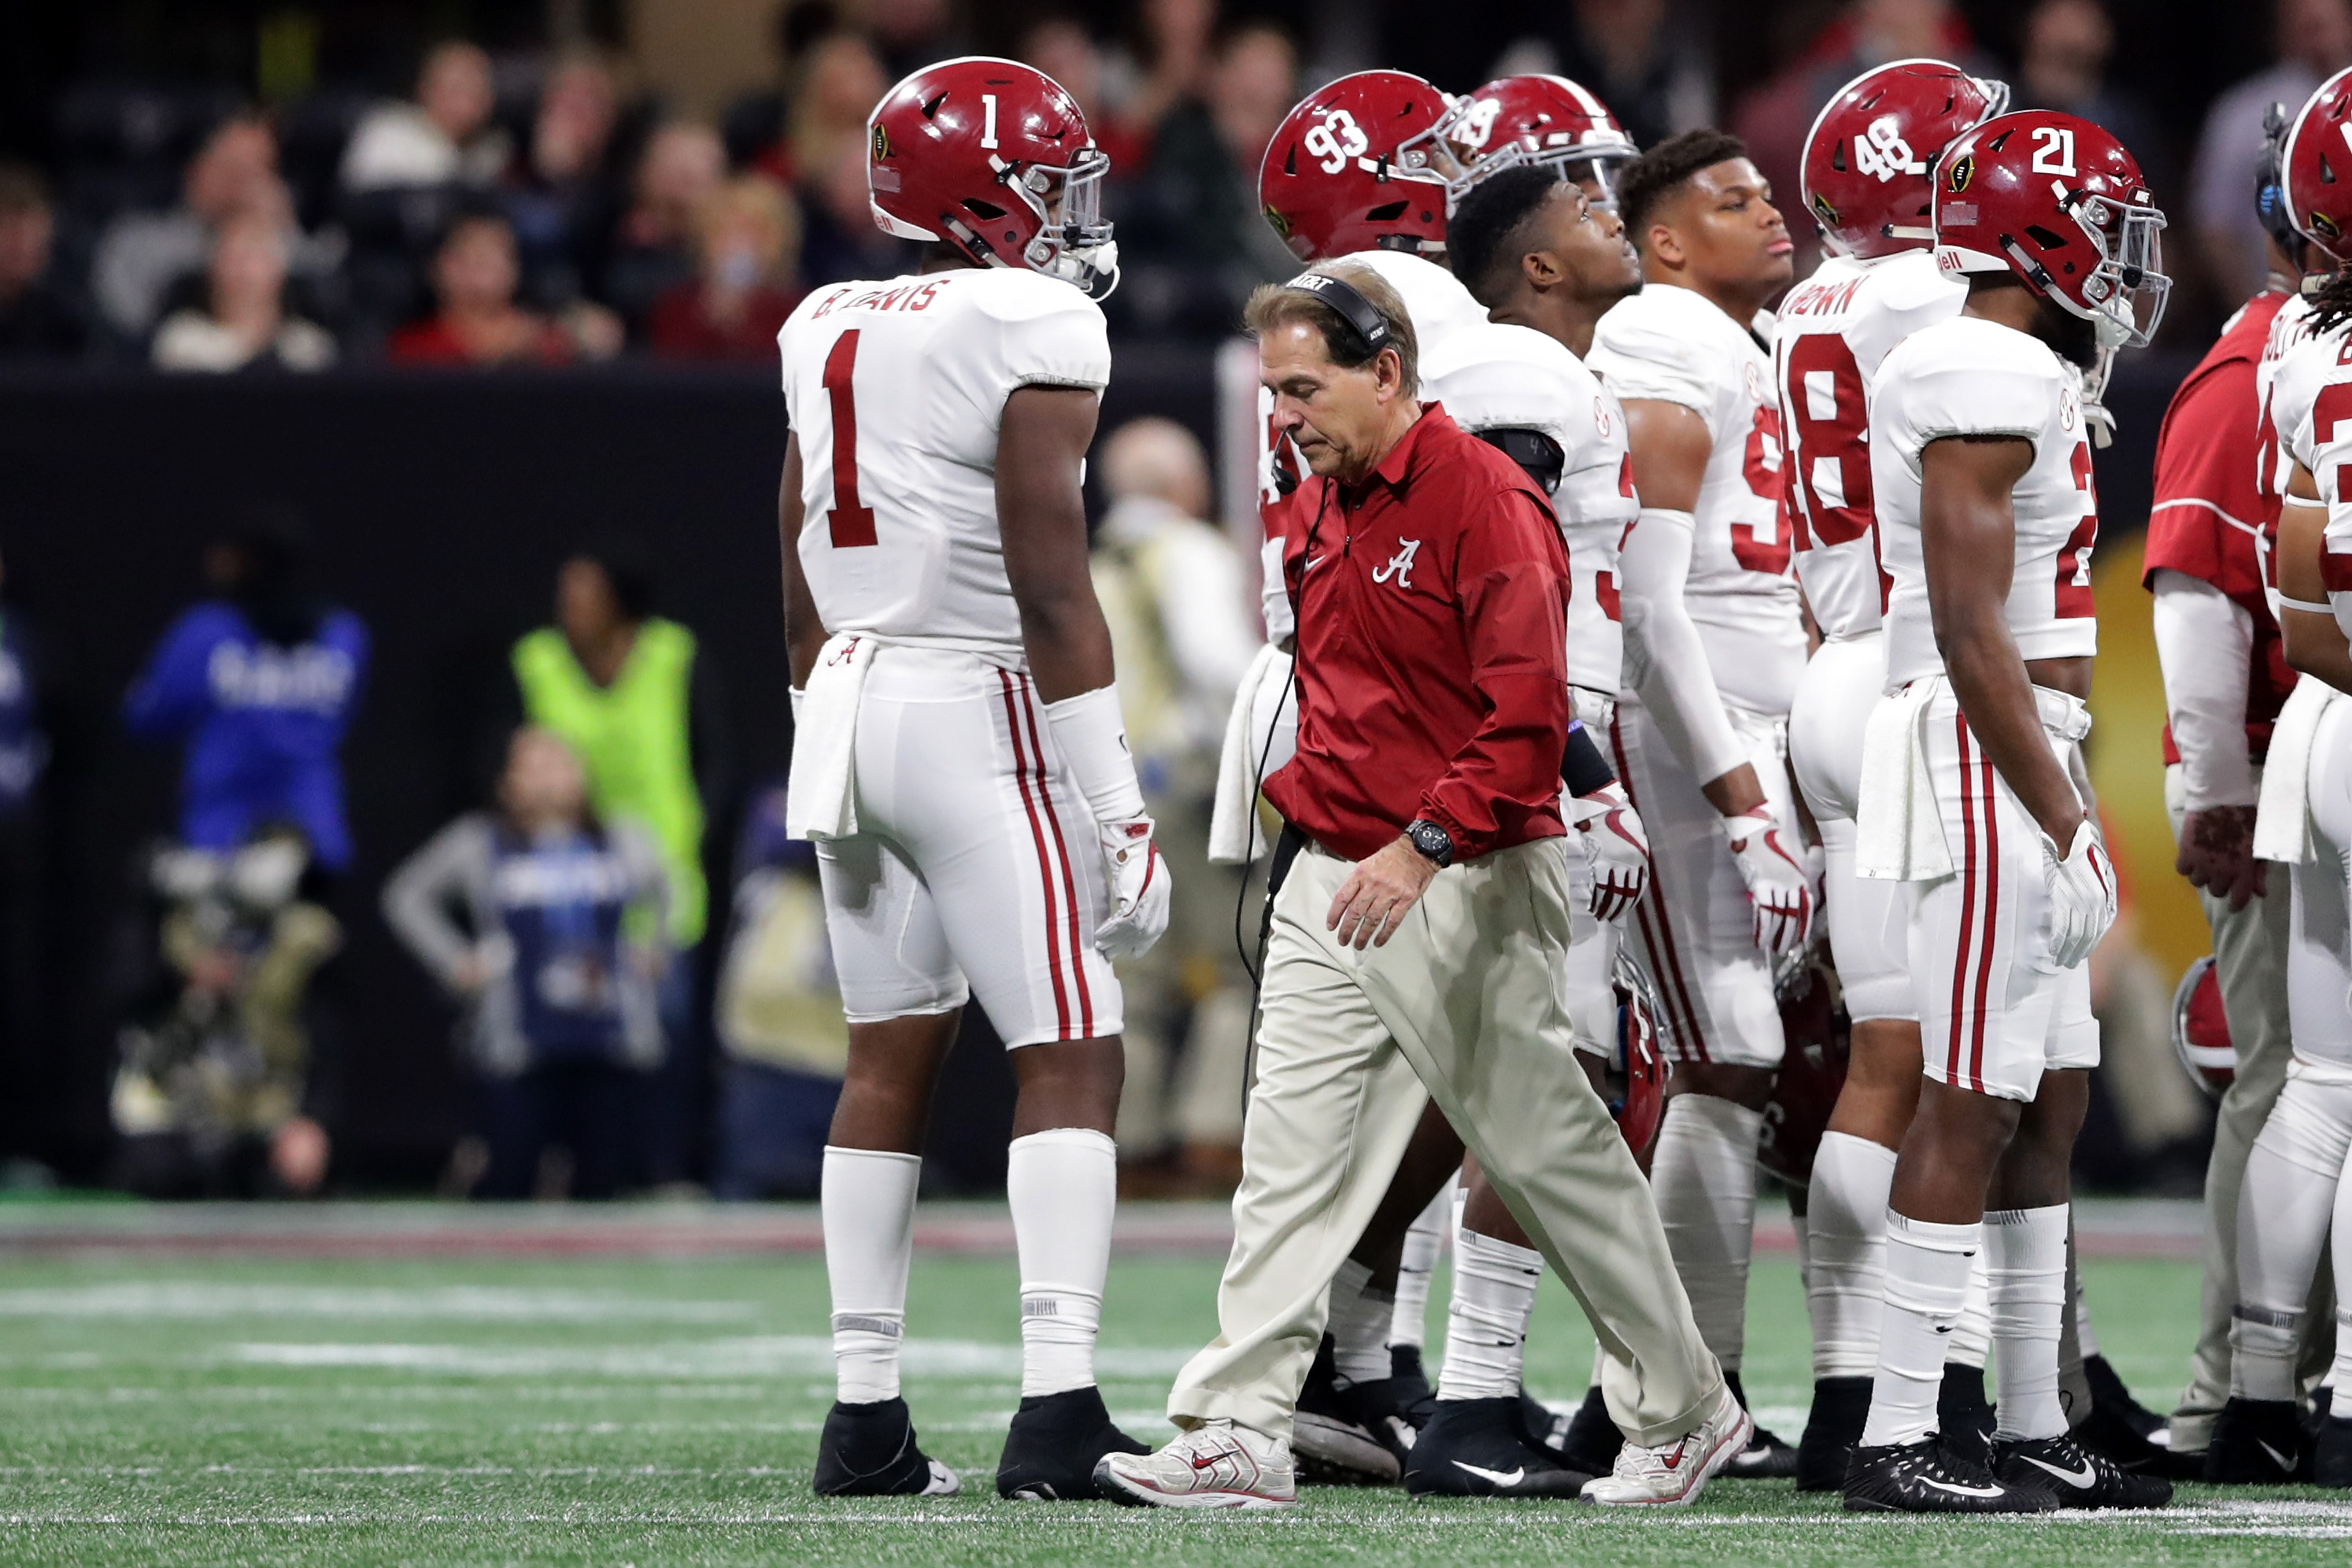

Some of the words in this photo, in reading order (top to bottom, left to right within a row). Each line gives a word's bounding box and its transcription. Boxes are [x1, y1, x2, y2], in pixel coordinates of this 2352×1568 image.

[979, 94, 999, 150] 1
[1304, 109, 1369, 175] 93
[1853, 117, 1914, 183] 48
[2031, 126, 2078, 178] 21
[838, 279, 951, 312] DAVIS
[1285, 274, 1334, 291] AT&T
[1369, 326, 1385, 342] AT&T
[822, 328, 878, 549] 1
[1372, 535, 1421, 589] A
[827, 636, 862, 667] A
